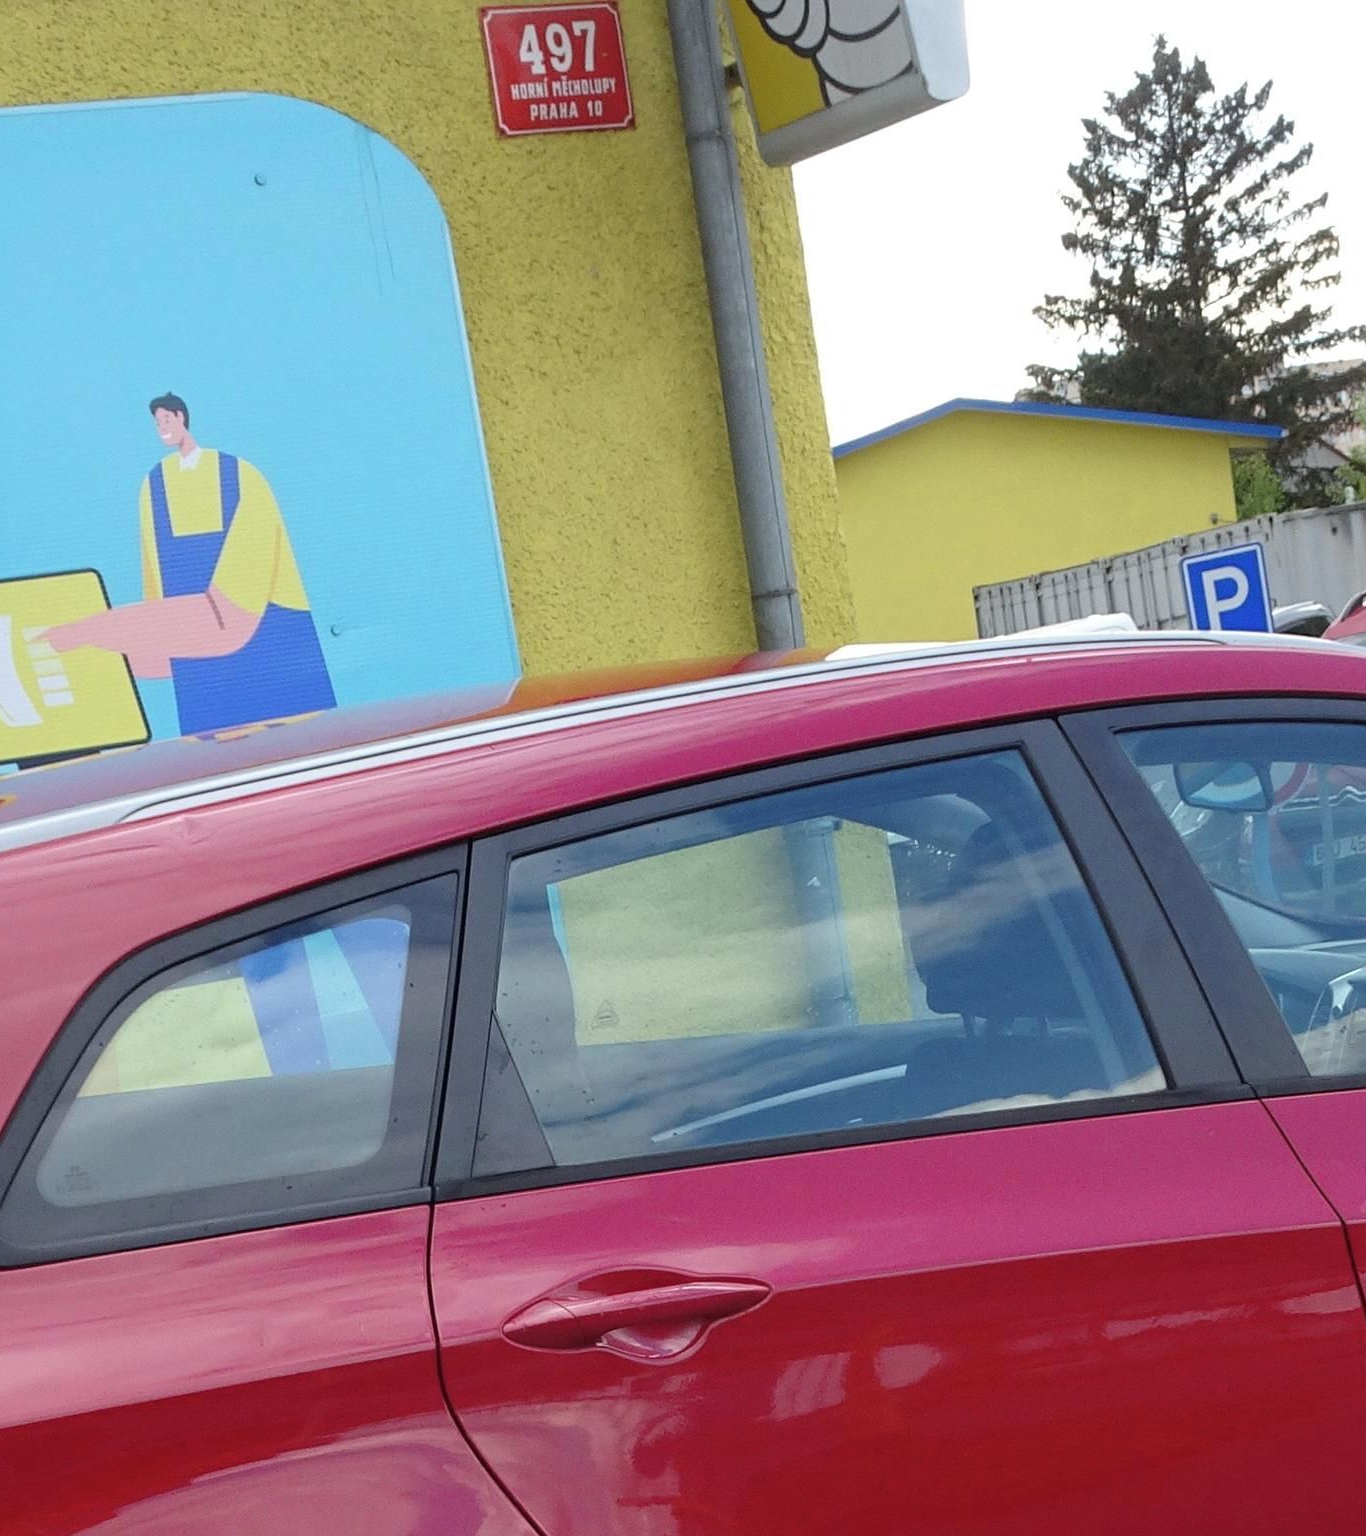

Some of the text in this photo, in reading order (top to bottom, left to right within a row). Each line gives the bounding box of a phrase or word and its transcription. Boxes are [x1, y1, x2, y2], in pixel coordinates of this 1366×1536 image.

[519, 20, 595, 74] 497
[510, 76, 616, 100] HORNÍ MĚCHOLUPY
[530, 100, 603, 121] PRAHA 10
[1202, 566, 1249, 631] P
